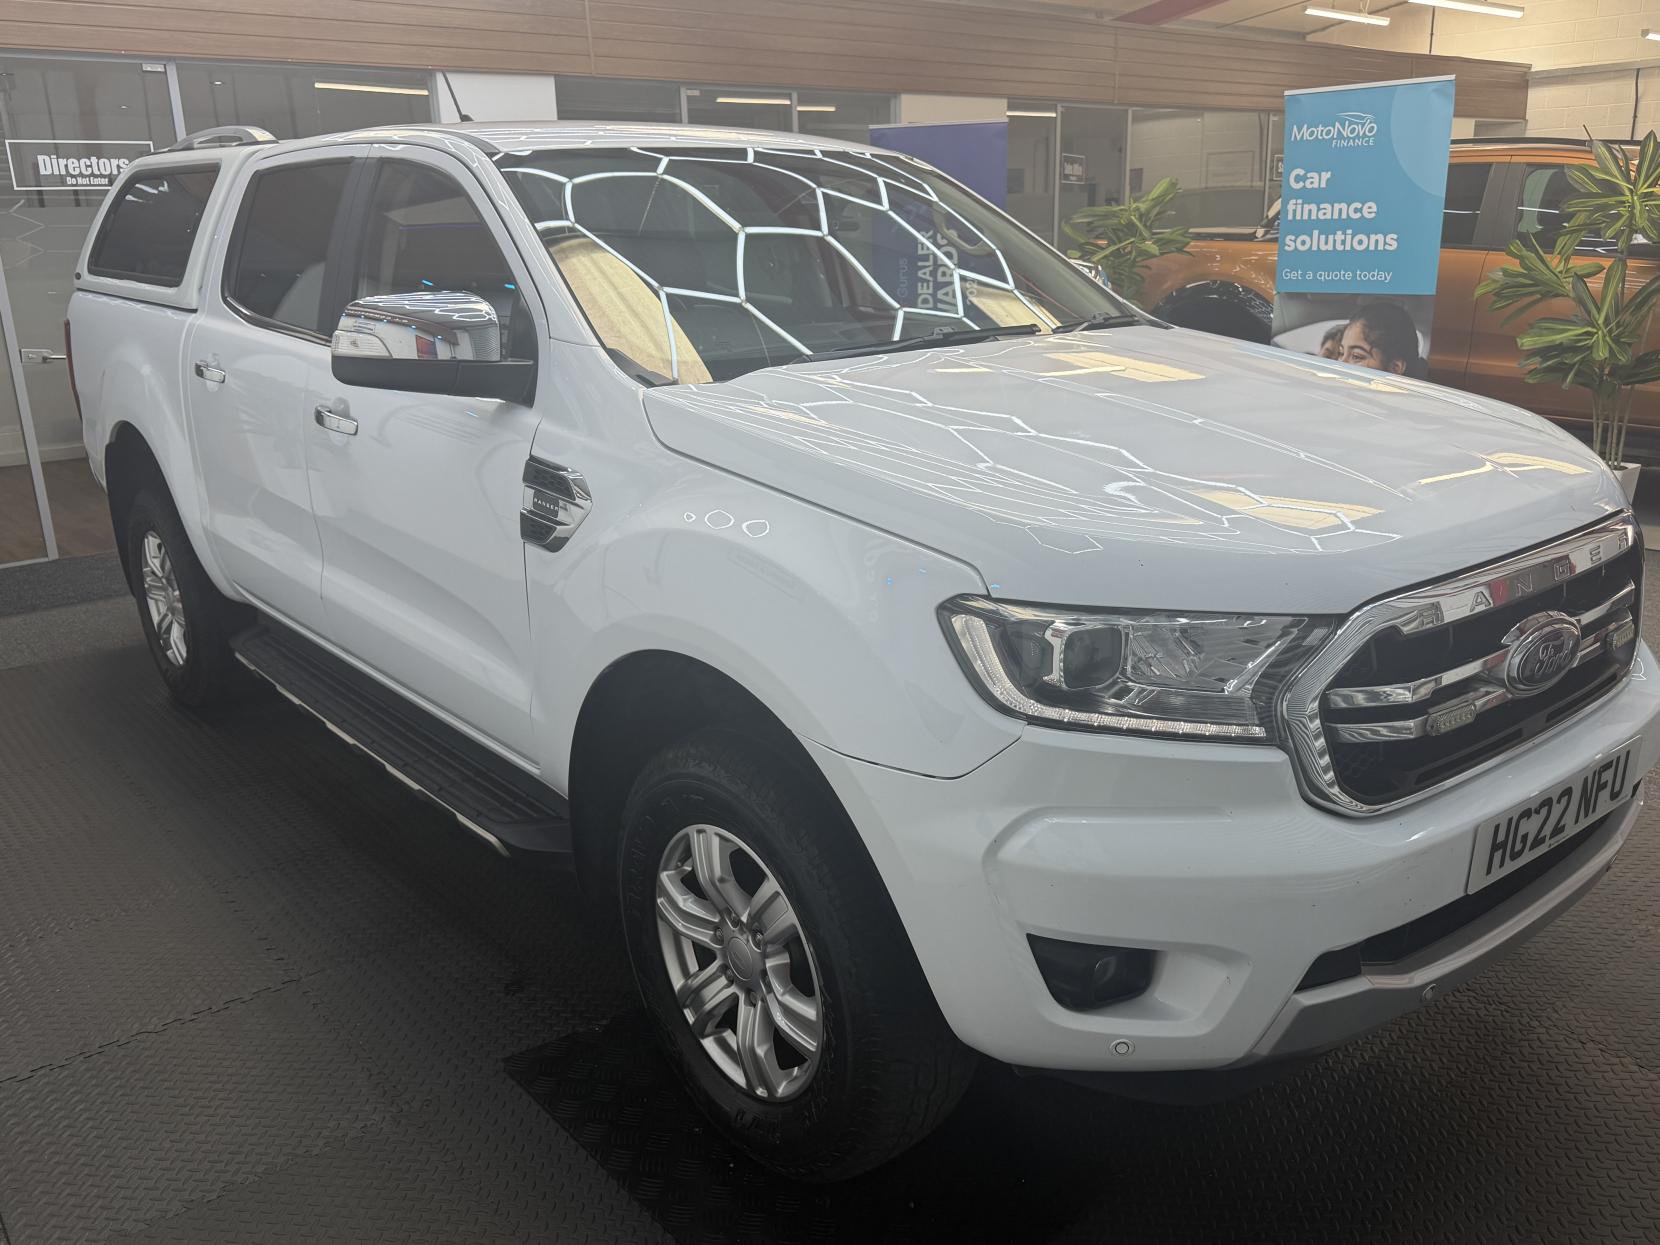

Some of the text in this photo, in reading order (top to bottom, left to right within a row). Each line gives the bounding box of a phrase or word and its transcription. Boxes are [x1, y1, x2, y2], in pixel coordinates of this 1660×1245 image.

[1291, 119, 1377, 141] MotoNovo
[1332, 137, 1375, 148] FINANCE
[37, 154, 130, 175] Directors
[66, 176, 109, 185] Do Not Enter
[1288, 168, 1332, 190] Car
[1286, 199, 1377, 221] finance
[1284, 229, 1398, 252] solutions
[917, 230, 934, 309] DEALER
[1282, 268, 1392, 283] Get a quote today
[1533, 636, 1573, 678] Ford
[1485, 749, 1631, 877] HG22 NFU
